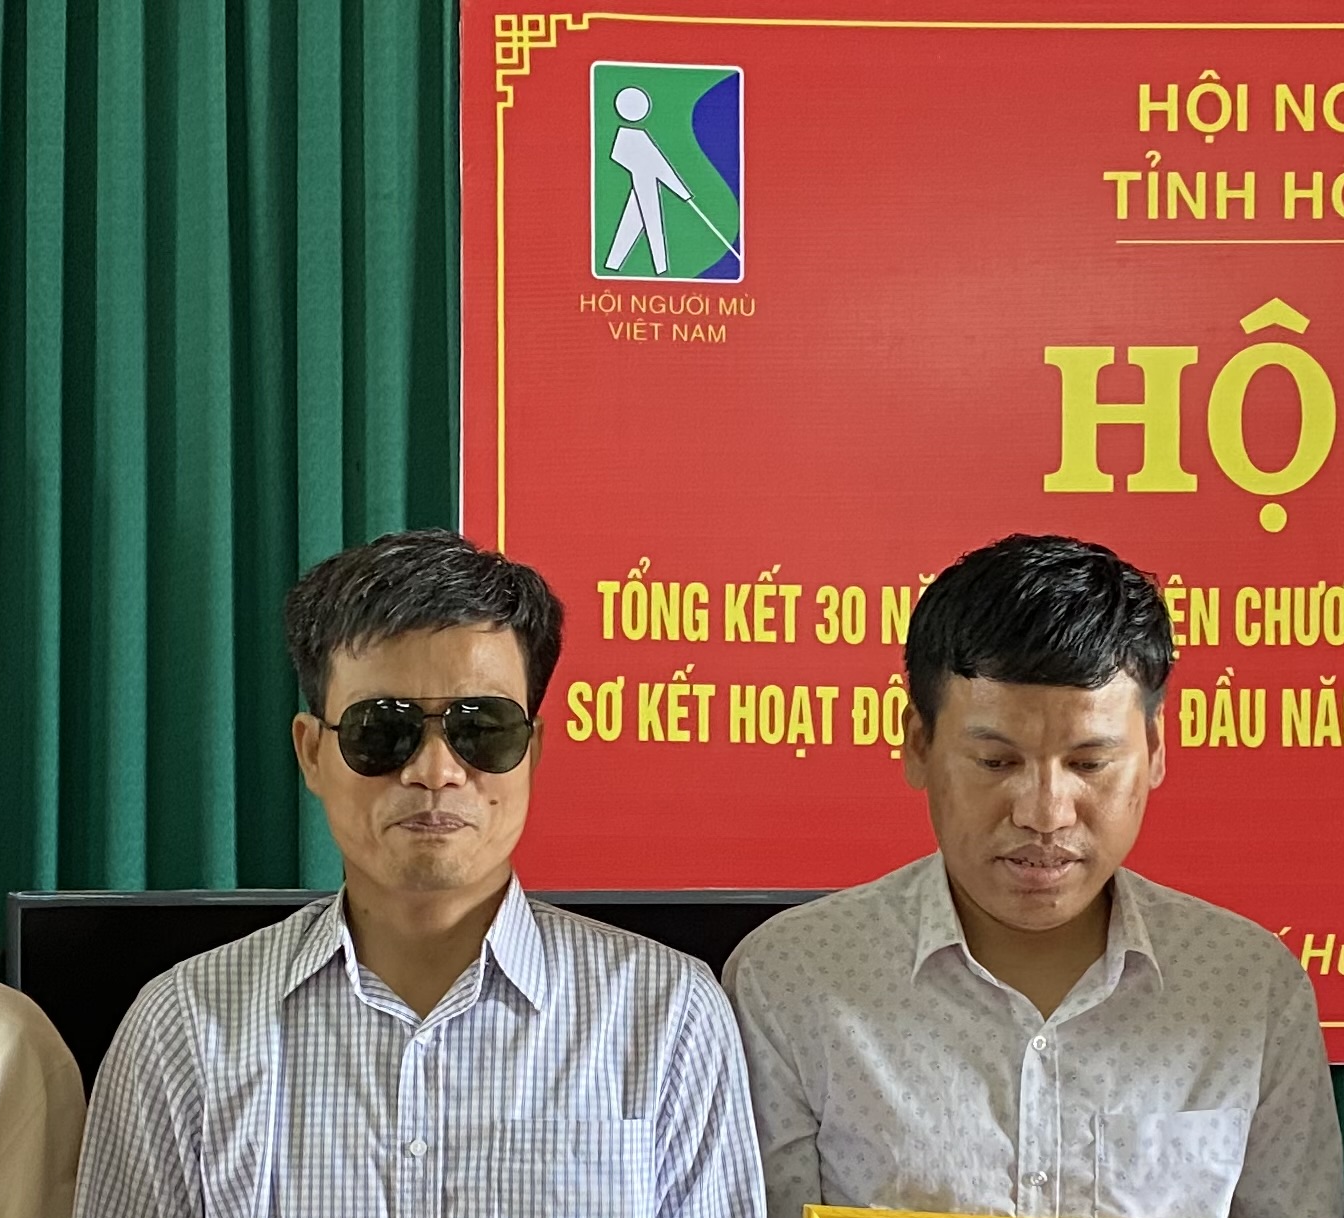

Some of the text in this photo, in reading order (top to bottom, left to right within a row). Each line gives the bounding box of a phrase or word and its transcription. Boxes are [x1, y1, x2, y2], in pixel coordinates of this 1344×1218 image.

[1138, 68, 1250, 145] HỘI
[1103, 150, 1257, 221] TỈNH
[579, 288, 756, 317] HỘI NGƯỜI MÙ
[607, 317, 728, 345] VIỆT NAM
[596, 556, 710, 642] TỔNG
[724, 563, 803, 643] KẾT
[814, 585, 867, 645] 30
[1163, 573, 1220, 660] ỆN
[566, 675, 625, 742] SƠ
[637, 663, 717, 743] KẾT
[728, 684, 840, 758] HOẠT
[851, 673, 910, 760] ĐỘ
[1178, 666, 1267, 748] ĐẦU
